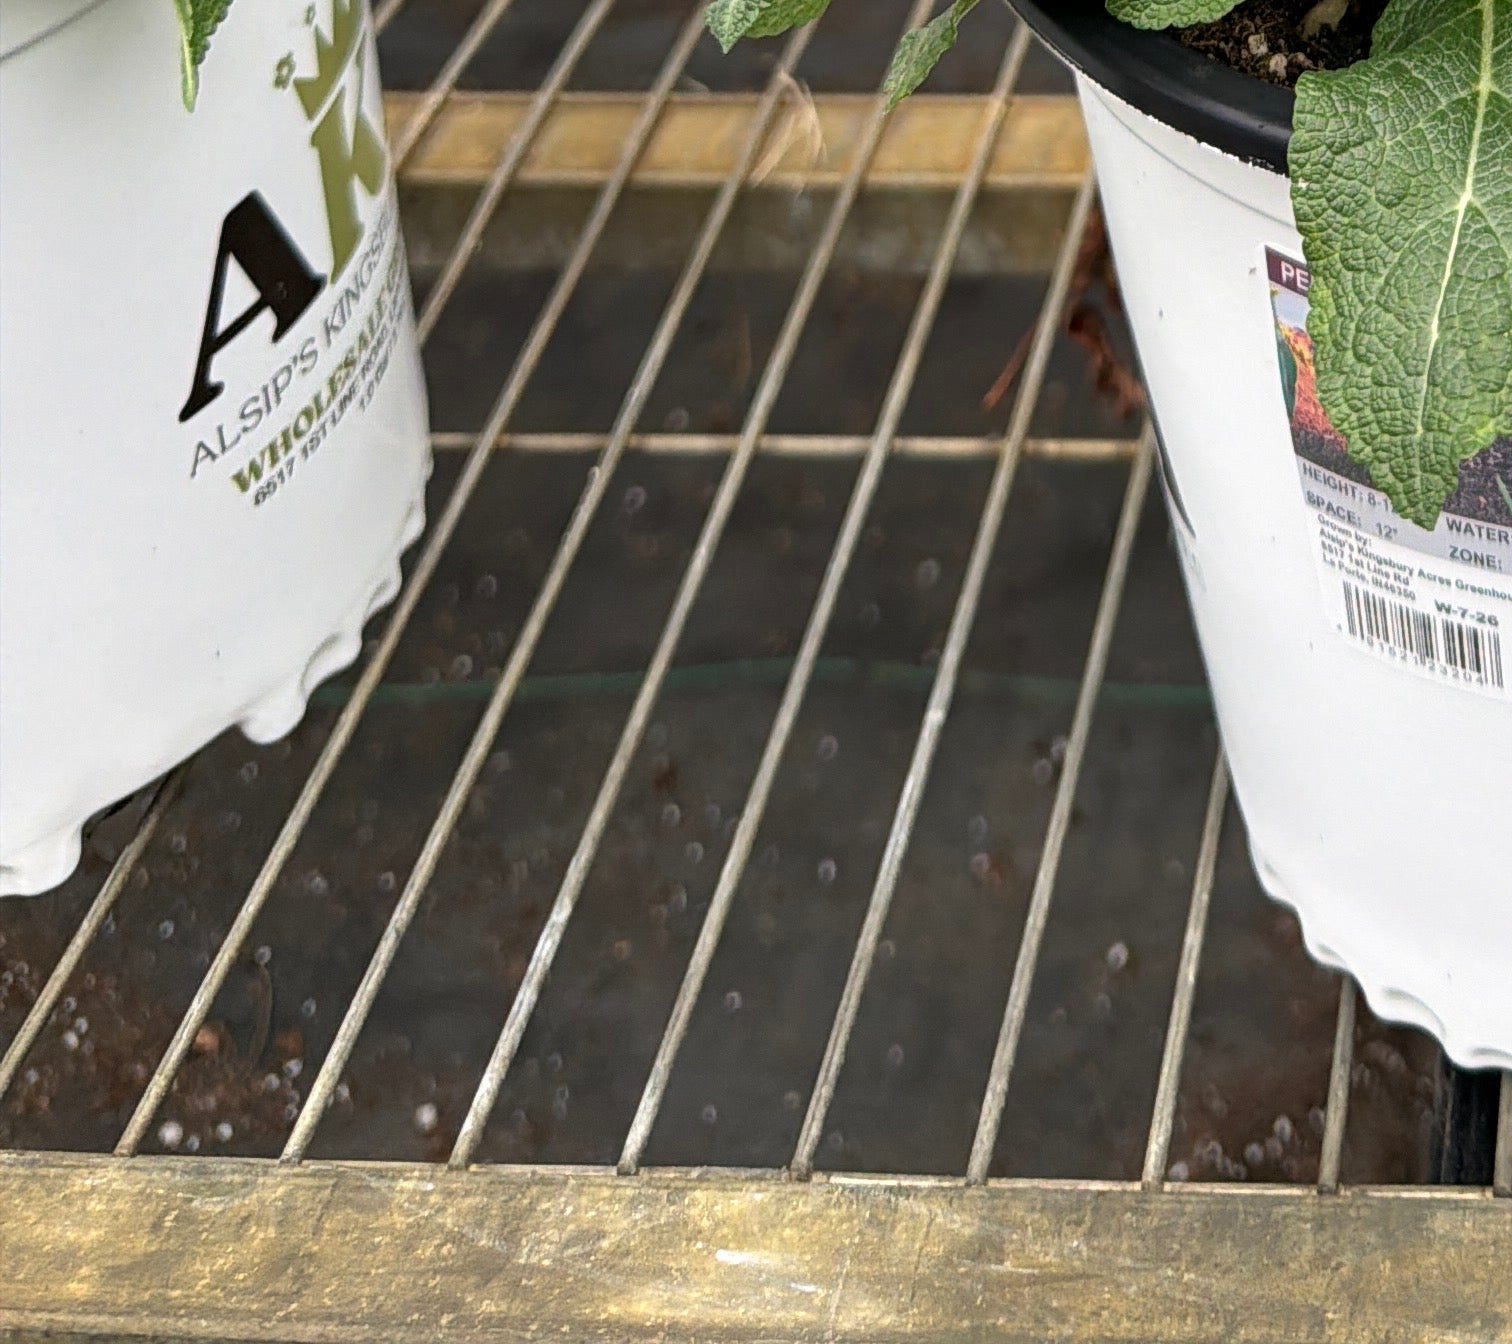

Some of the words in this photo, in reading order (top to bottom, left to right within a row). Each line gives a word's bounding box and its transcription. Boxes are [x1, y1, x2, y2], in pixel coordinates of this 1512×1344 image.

[1280, 260, 1310, 292] PE
[190, 335, 319, 480] ALSIP'S
[1302, 463, 1364, 503] HEIGHT:
[1305, 490, 1362, 529] SPACE:
[1357, 544, 1415, 578] Kingsbury
[1417, 566, 1453, 587] Acres
[1449, 544, 1503, 571] ZONE:
[1434, 598, 1500, 628] W-7-26
